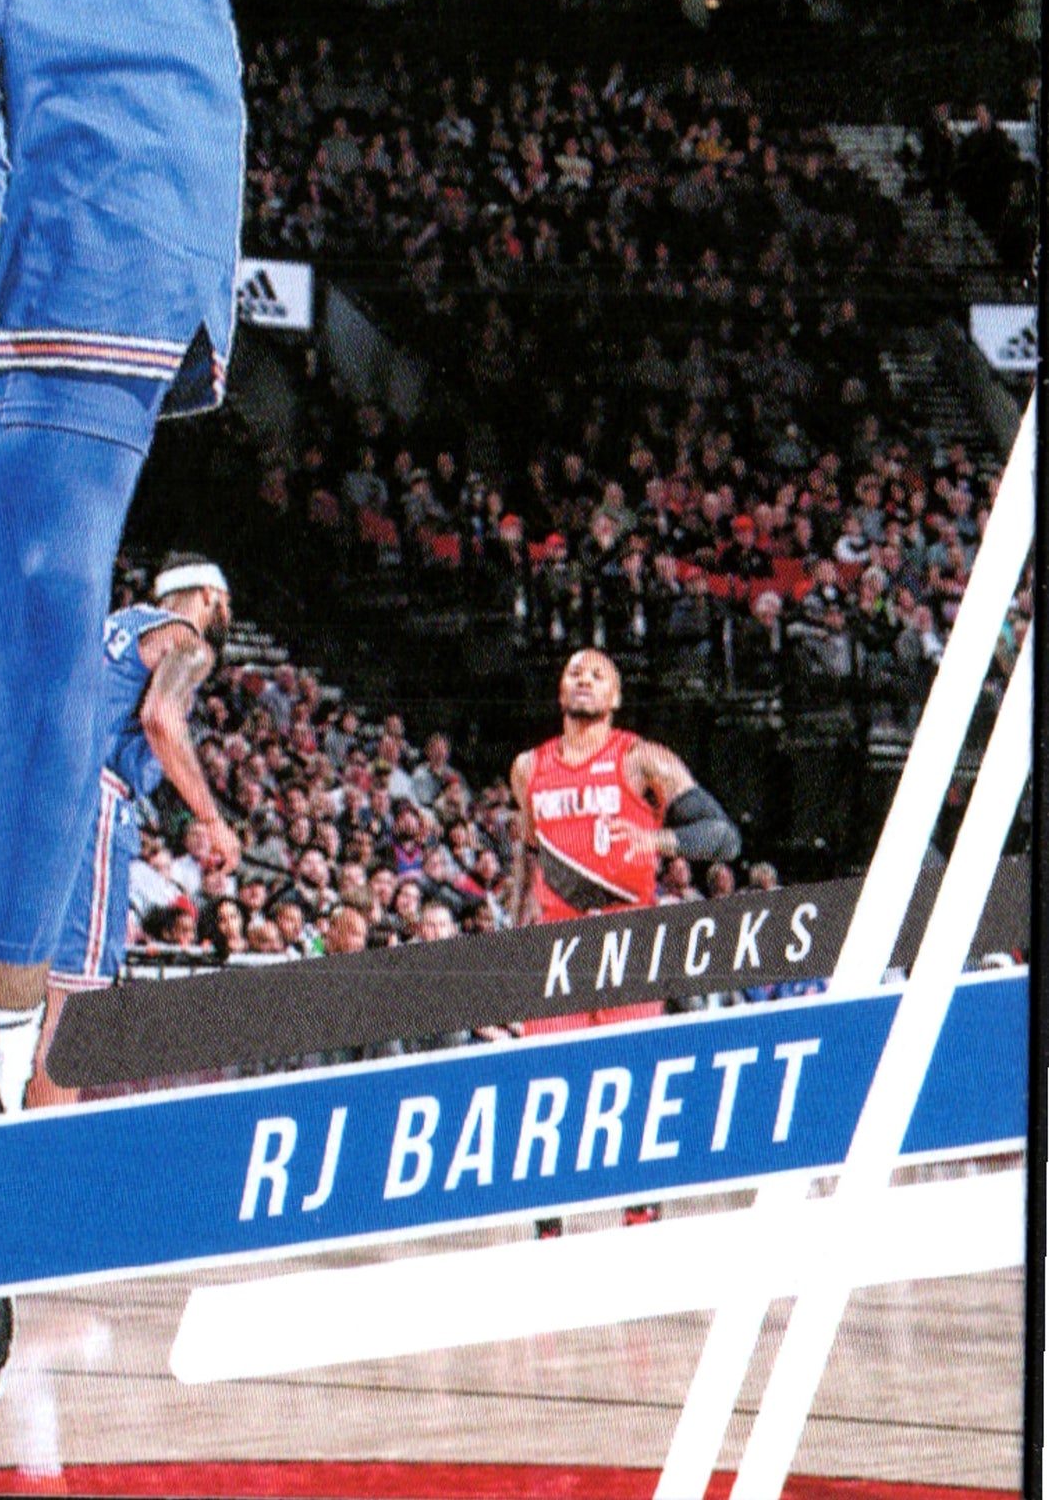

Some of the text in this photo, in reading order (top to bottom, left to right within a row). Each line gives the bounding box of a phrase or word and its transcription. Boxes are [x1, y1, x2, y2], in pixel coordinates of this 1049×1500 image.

[544, 902, 819, 998] KNICKS
[239, 1039, 821, 1221] RJ BARRETT
